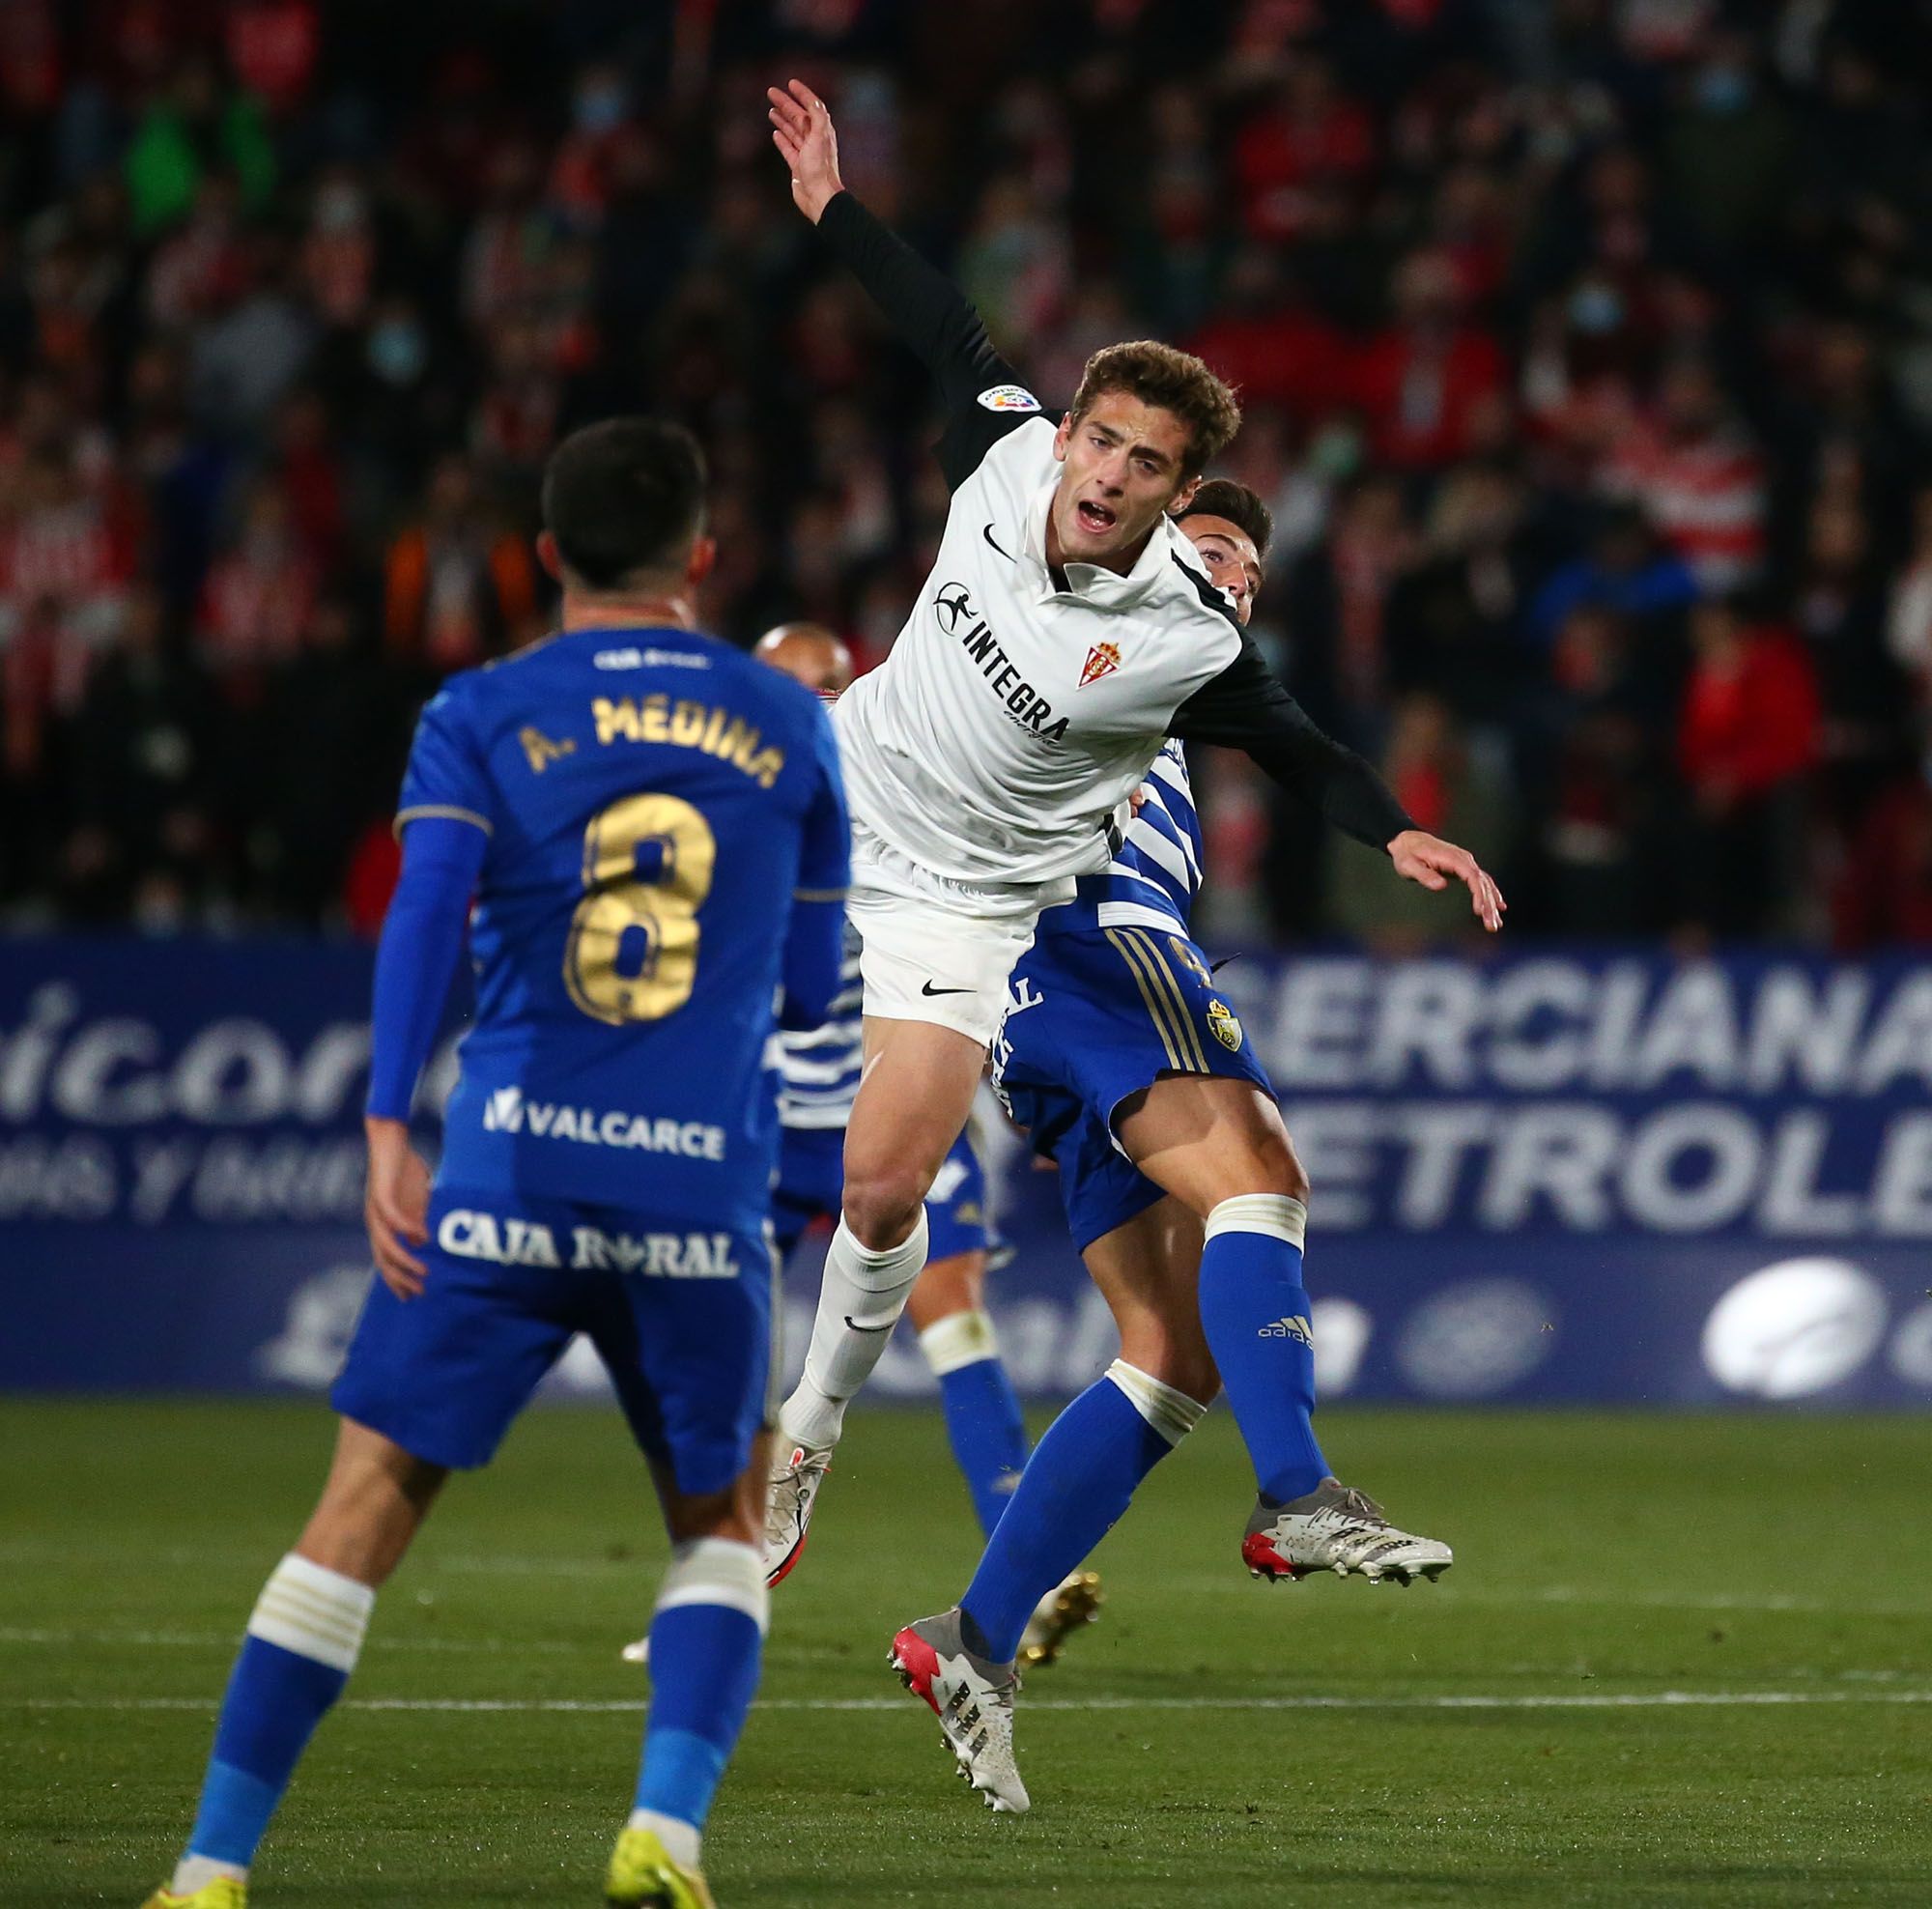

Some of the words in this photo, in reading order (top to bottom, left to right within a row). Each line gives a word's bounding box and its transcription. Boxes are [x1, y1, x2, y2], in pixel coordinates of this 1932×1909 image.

[962, 620, 1070, 742] INTEGRA
[519, 726, 576, 774] A.
[563, 792, 717, 1027] 8
[1212, 954, 1932, 1097] ERCIANA
[526, 1100, 725, 1161] VALCARCE
[438, 1209, 562, 1269] CAJA
[1258, 1326, 1315, 1353] adida
